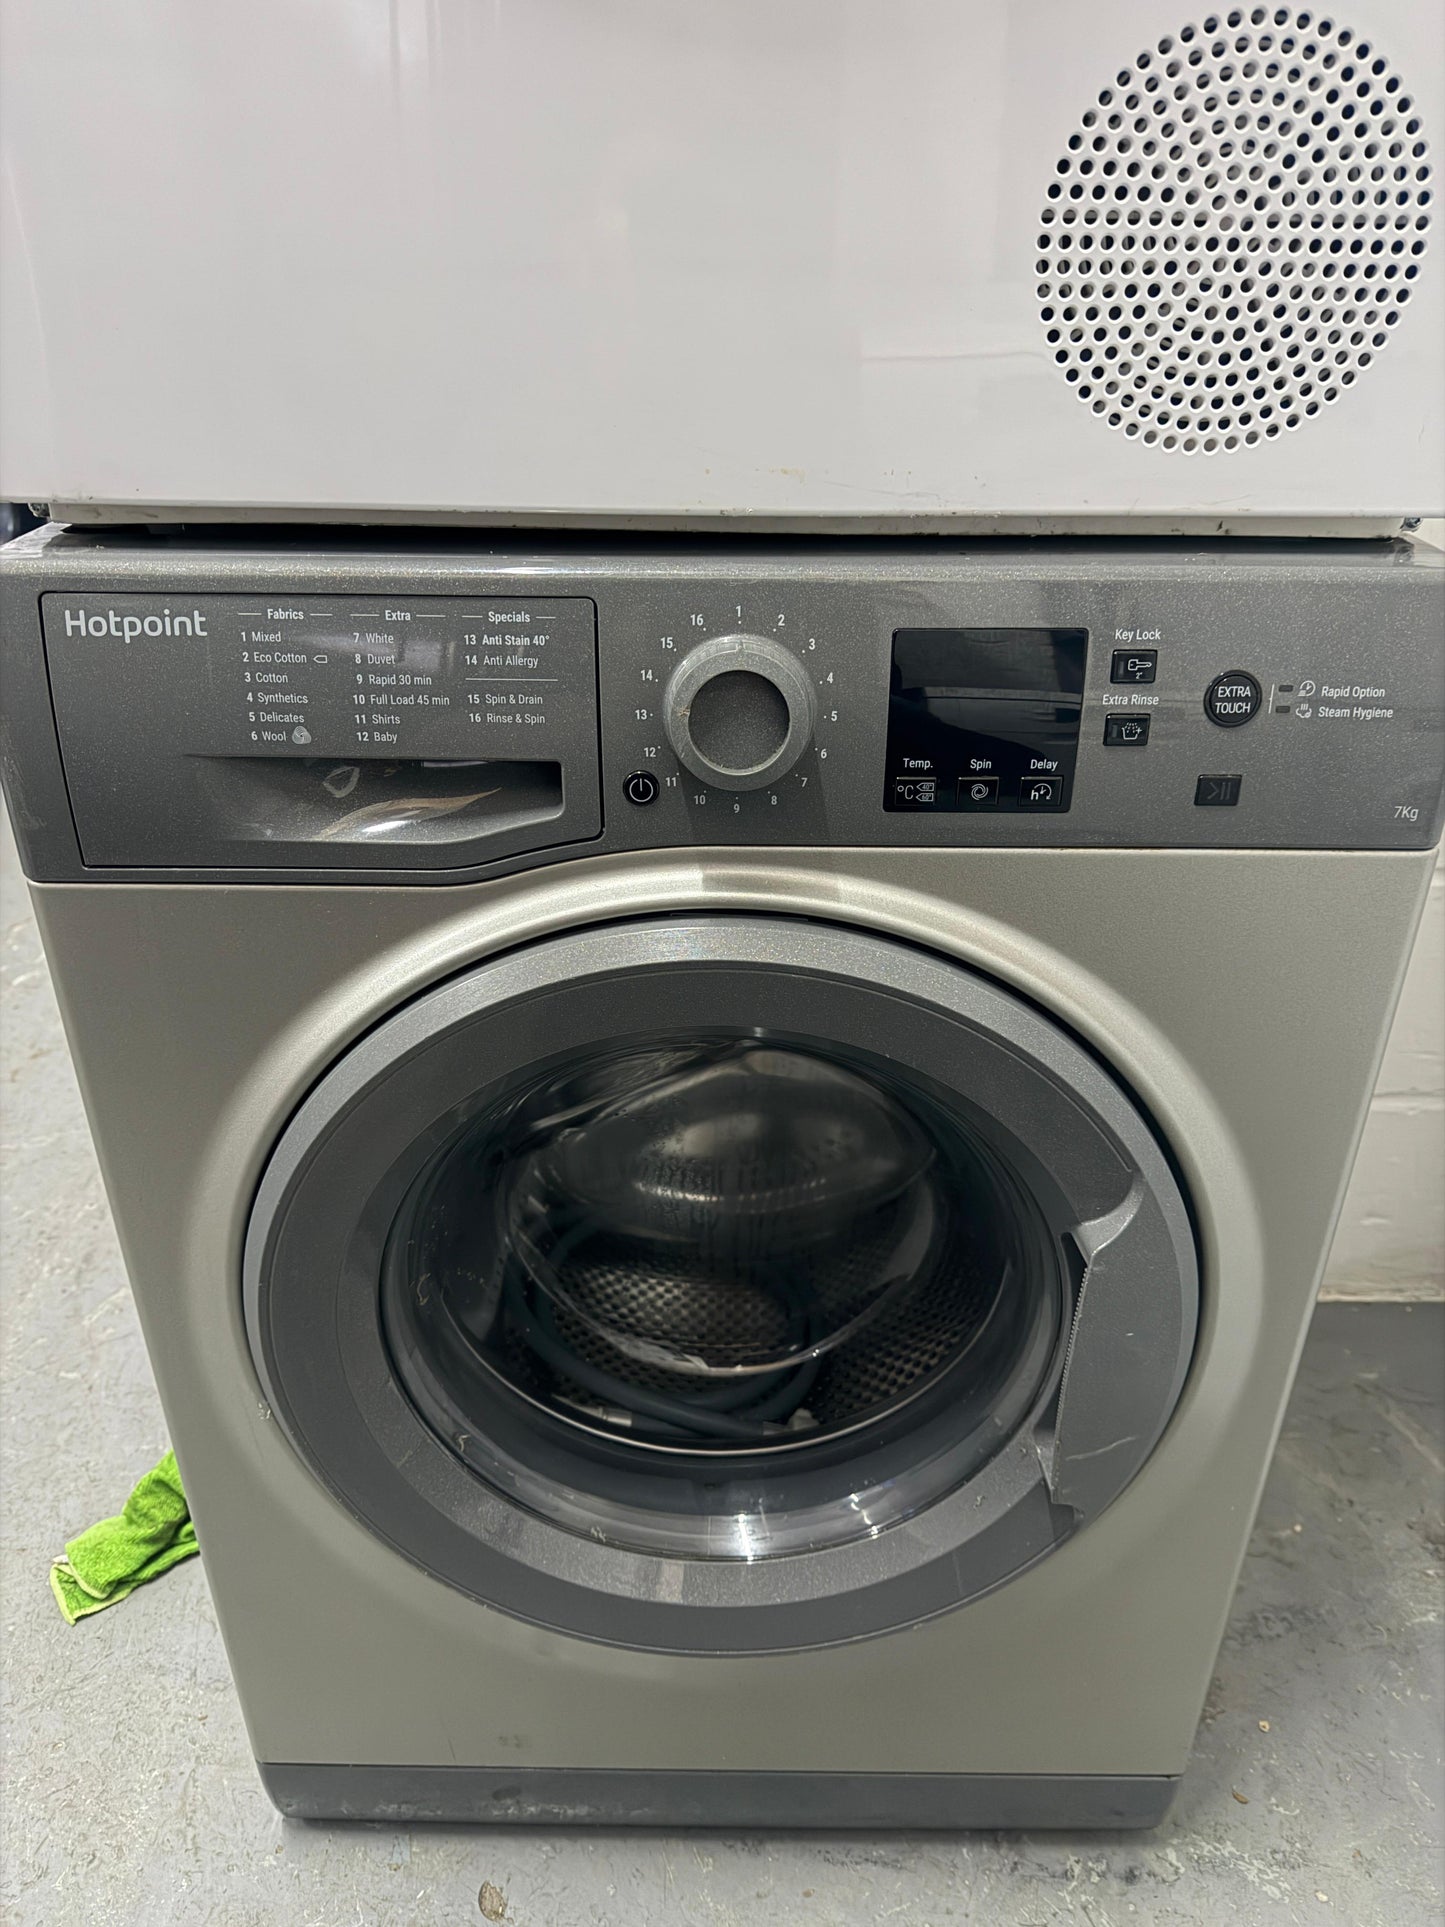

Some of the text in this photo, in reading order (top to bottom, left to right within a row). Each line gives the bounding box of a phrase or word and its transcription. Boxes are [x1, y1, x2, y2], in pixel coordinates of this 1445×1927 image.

[267, 609, 304, 621] Fabrics
[385, 610, 411, 621] Extra
[736, 606, 742, 618] 1
[488, 612, 530, 625] Specials
[690, 614, 704, 626] 16
[778, 615, 785, 626] 2
[65, 609, 208, 644] Hotpoint
[241, 632, 282, 643] 1 Mixed
[353, 633, 394, 644] 7 White
[464, 635, 550, 646] 13 Anti Stain 40°
[1115, 629, 1162, 642] Key Lock
[661, 637, 674, 649] 15
[809, 639, 816, 650] 3
[242, 652, 307, 664] 2 Eco Cotton
[355, 654, 396, 665] 8 Duvet
[465, 655, 539, 668] 14 Anti Allergy
[245, 673, 289, 684] 3 Cotton
[641, 670, 653, 681] 14
[827, 672, 834, 684] 4
[357, 675, 432, 688] 9 Rapid 30 min
[1218, 686, 1251, 697] EXTRA
[1321, 686, 1386, 700] Rapid Option
[247, 693, 309, 705] 4 Synthetics
[353, 695, 450, 706] 10 Full Load 45 min
[468, 695, 543, 707] 15 Spin & Drain
[1103, 694, 1160, 706] Extra Rinse
[1216, 703, 1251, 714] TOUCH
[1318, 707, 1394, 720] Steam Hygiene
[249, 712, 305, 723] 5 Delicates
[355, 715, 401, 725] 11 Shirts
[469, 713, 546, 726] 16 Rinse & Spin
[635, 710, 648, 720] 13
[831, 711, 838, 721] 5
[251, 731, 287, 742] 6 Wool
[357, 732, 398, 744] 12 Baby
[644, 748, 656, 758] 12
[821, 749, 827, 759] 6
[903, 758, 933, 770] Temp.
[970, 759, 992, 771] Spin
[1030, 759, 1059, 771] Delay
[666, 777, 677, 787] 11
[801, 778, 808, 788] 7
[694, 796, 706, 805] 10
[771, 796, 778, 805] 8
[734, 804, 740, 814] 9
[1394, 806, 1419, 821] 7Kg
